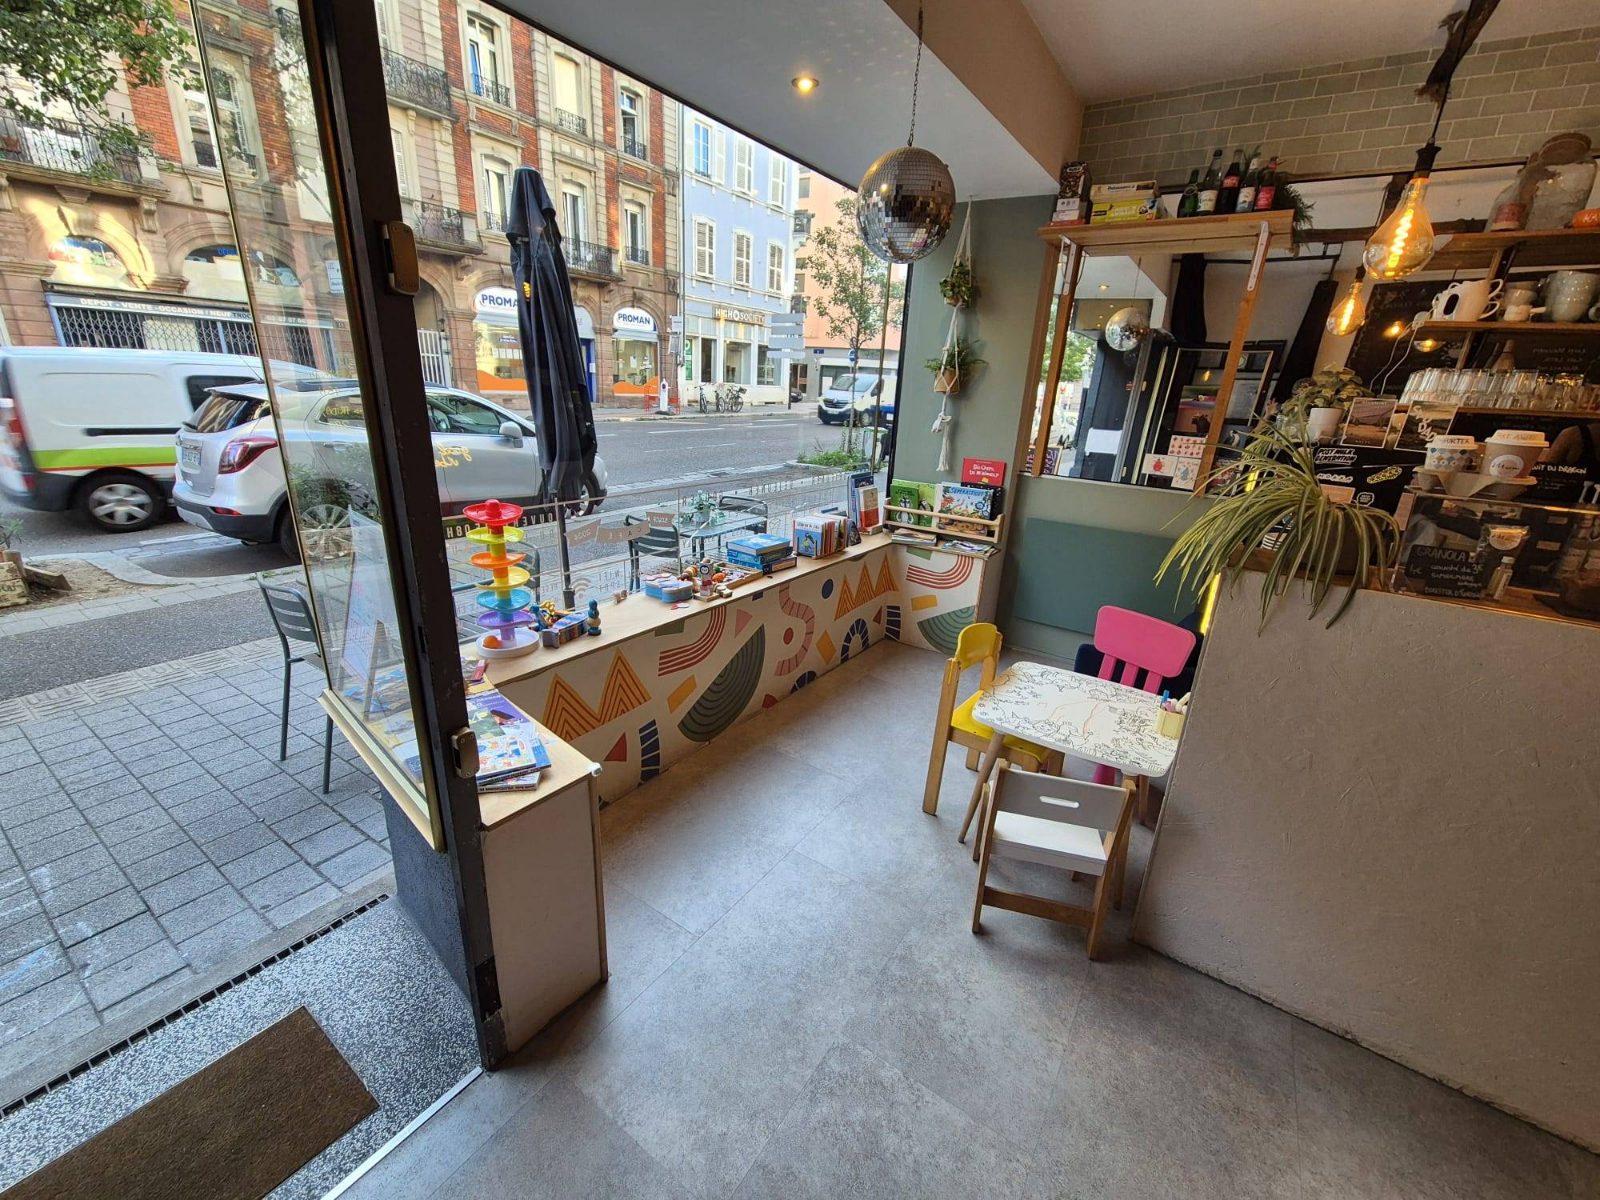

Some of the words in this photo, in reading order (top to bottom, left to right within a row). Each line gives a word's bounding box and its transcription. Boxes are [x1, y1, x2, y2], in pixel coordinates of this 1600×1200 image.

[80, 298, 113, 307] DEPOT
[121, 301, 154, 311] VENTE
[159, 305, 203, 315] OCCASION
[210, 310, 230, 318] NEUF
[481, 294, 518, 308] PROMA
[618, 313, 651, 325] PROMAN
[715, 307, 733, 320] HIGH
[739, 311, 766, 325] SOCIETY
[1416, 546, 1466, 562] GRANOLA
